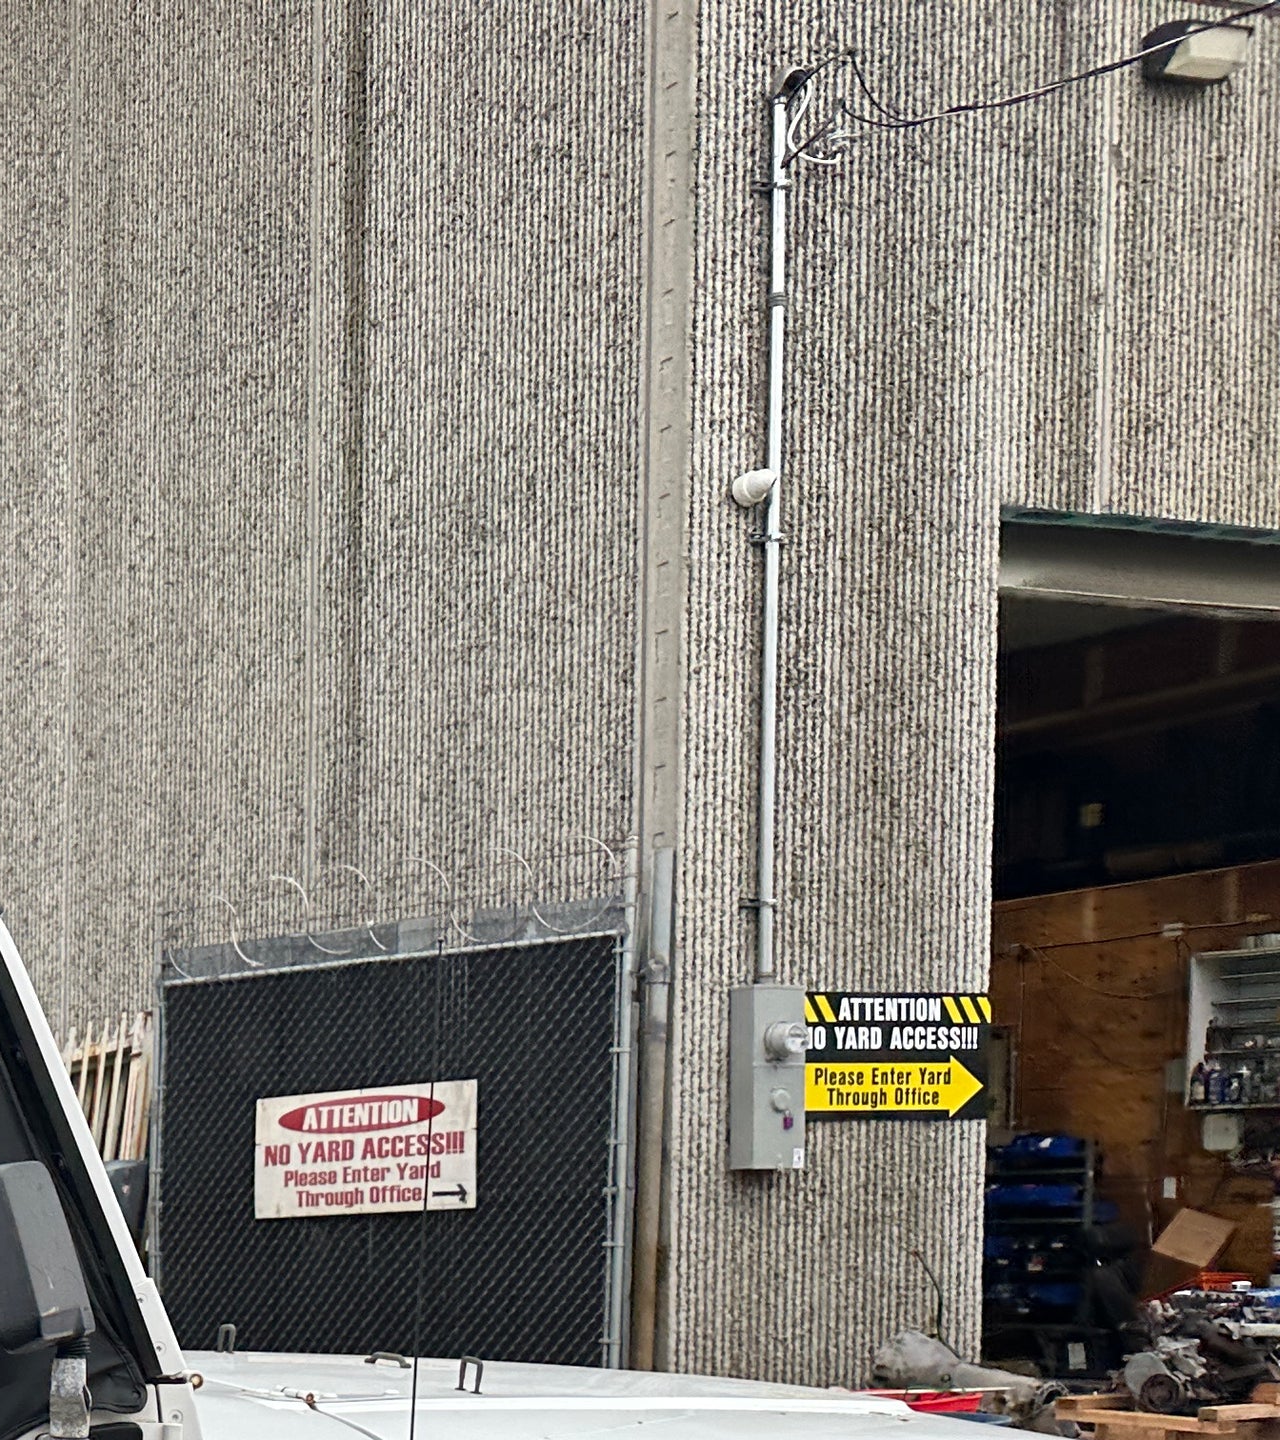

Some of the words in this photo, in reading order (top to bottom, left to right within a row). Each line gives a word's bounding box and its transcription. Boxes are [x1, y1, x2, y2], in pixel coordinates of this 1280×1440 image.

[839, 997, 942, 1022] ATTENTION
[834, 1026, 883, 1050] YARD
[890, 1026, 978, 1050] ACCESS!!!
[814, 1067, 865, 1086] Please
[871, 1067, 912, 1085] Enter
[918, 1067, 952, 1086] Yard
[827, 1088, 887, 1108] Through
[894, 1087, 939, 1106] Office
[302, 1099, 419, 1131] ATTENTION
[264, 1143, 290, 1168] NO
[298, 1137, 354, 1164] YARD
[361, 1131, 465, 1161] ACCESS!!!
[284, 1170, 337, 1188] Please
[342, 1166, 391, 1184] Enter
[396, 1161, 441, 1181] Yard
[296, 1187, 364, 1208] Through
